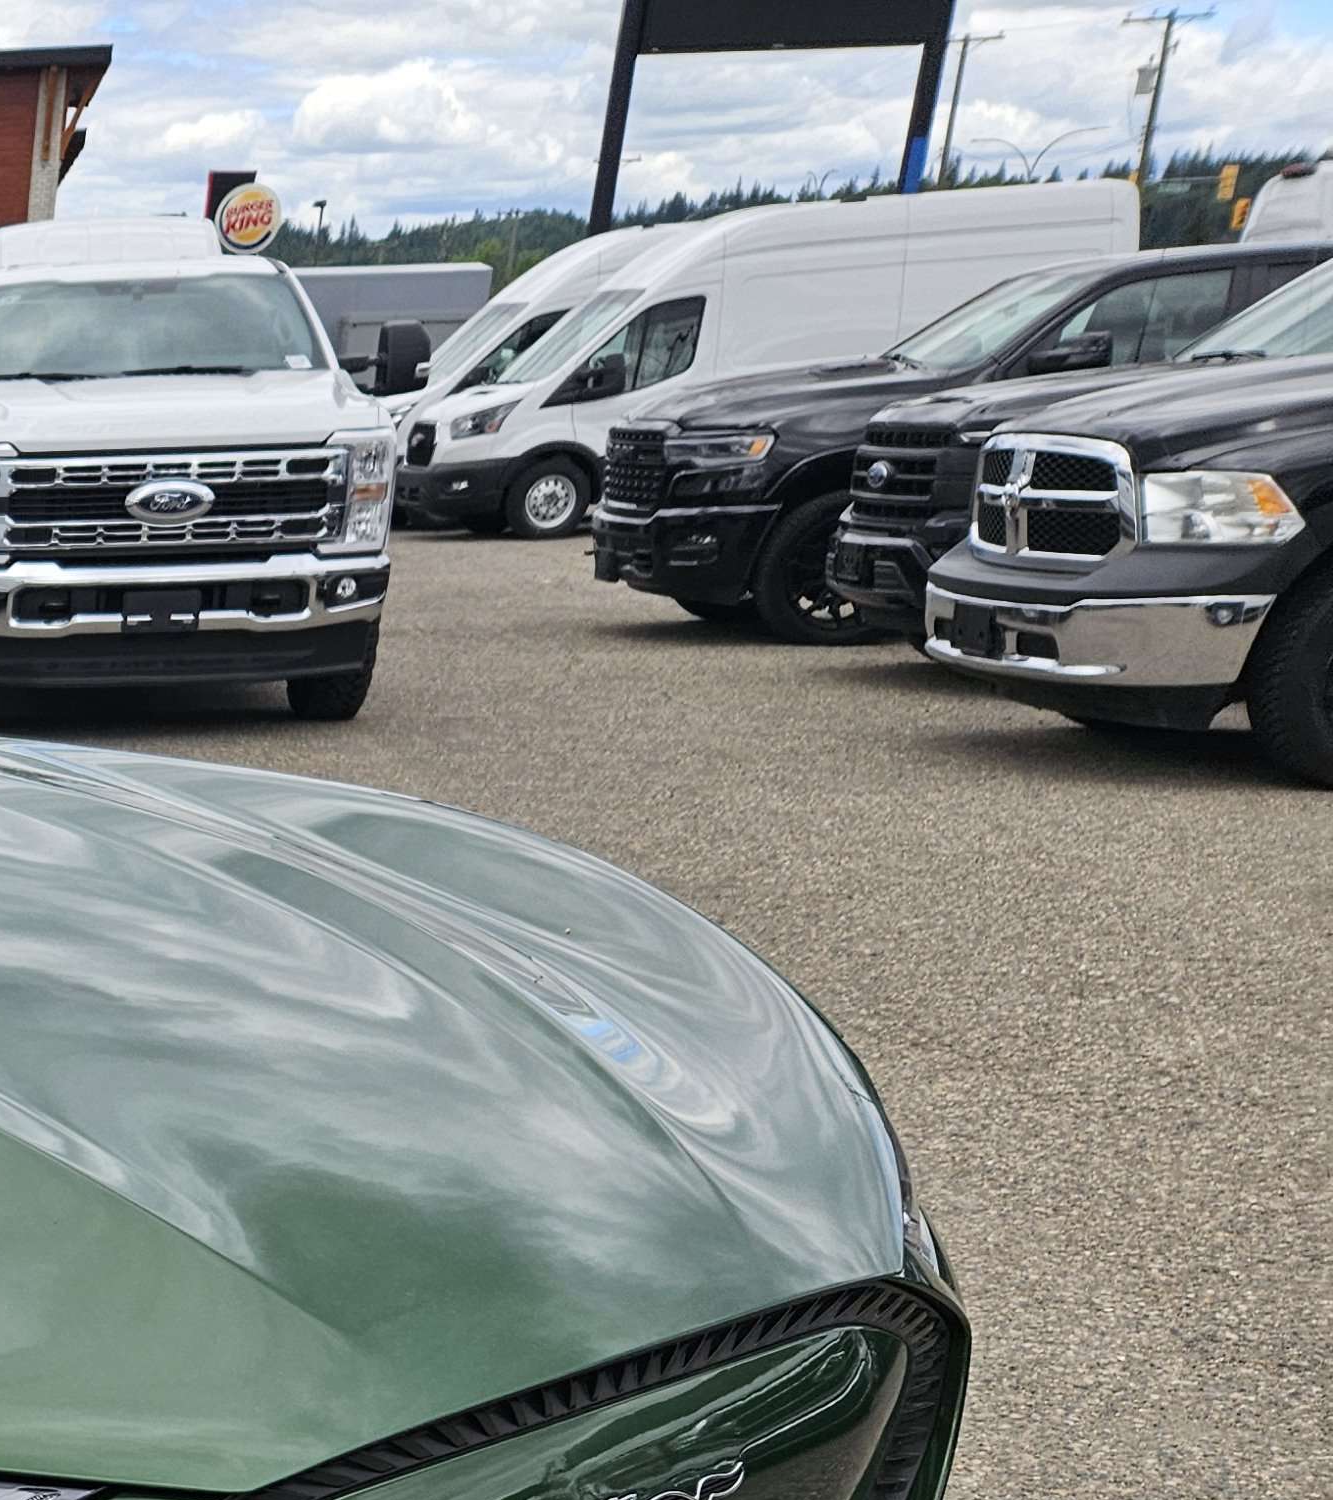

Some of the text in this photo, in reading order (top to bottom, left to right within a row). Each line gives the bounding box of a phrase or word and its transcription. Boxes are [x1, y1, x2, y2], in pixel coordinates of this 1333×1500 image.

[225, 200, 273, 219] BURGER
[224, 211, 273, 234] KING
[149, 493, 192, 511] Ford
